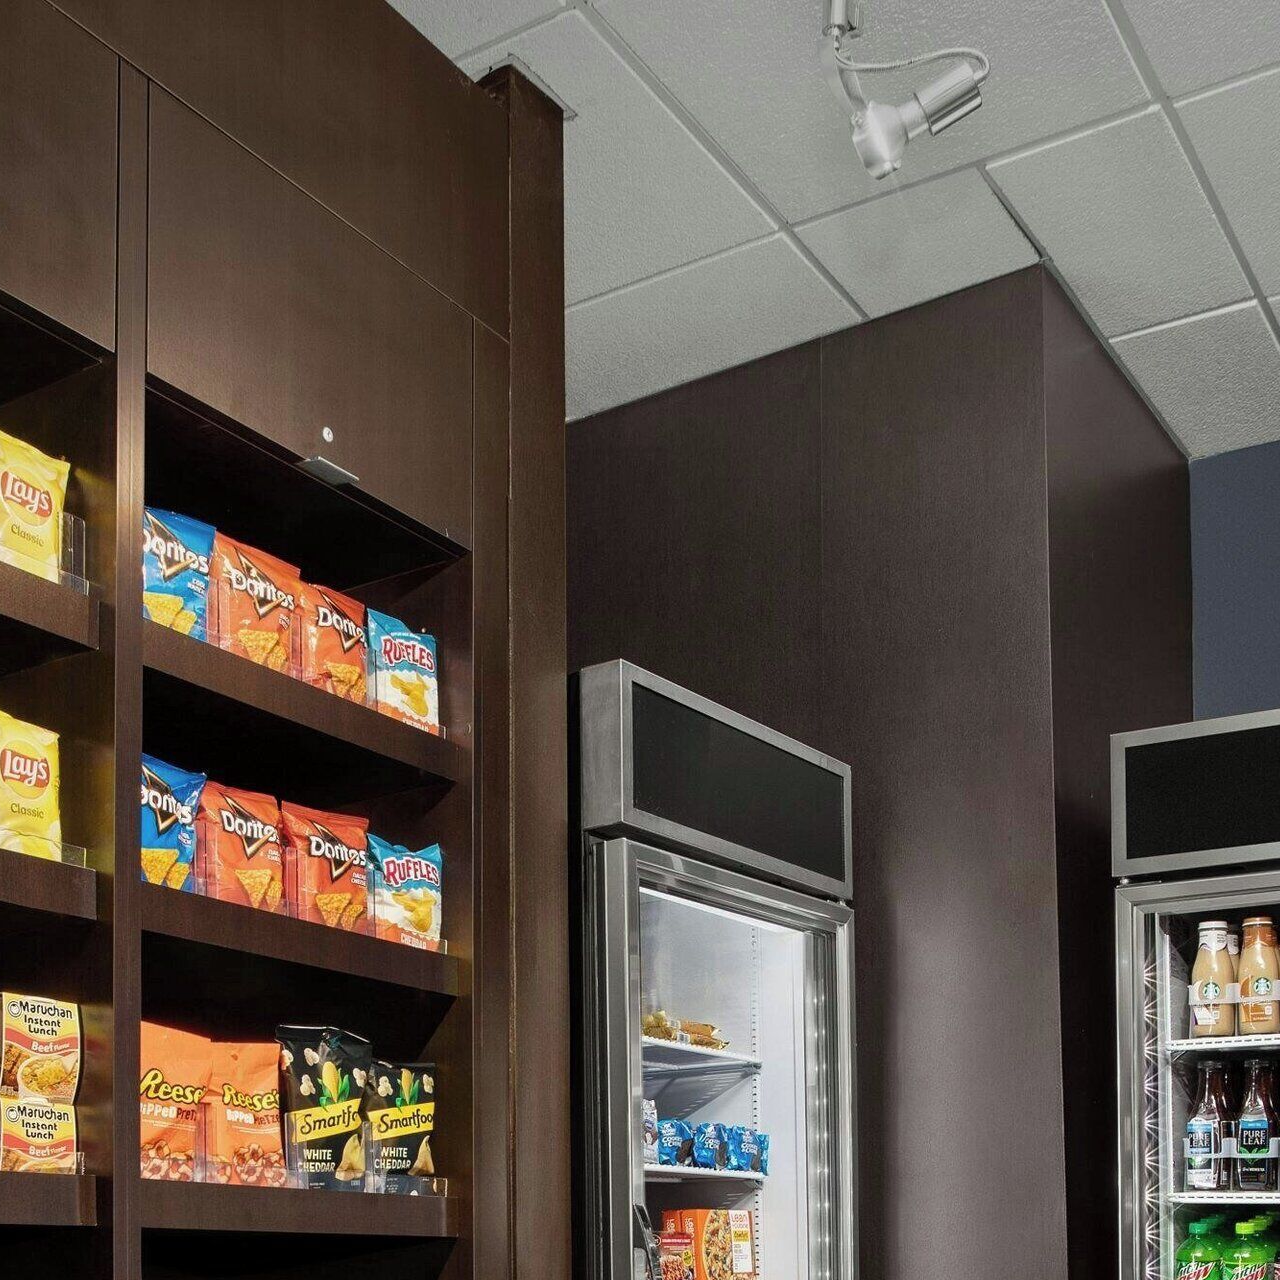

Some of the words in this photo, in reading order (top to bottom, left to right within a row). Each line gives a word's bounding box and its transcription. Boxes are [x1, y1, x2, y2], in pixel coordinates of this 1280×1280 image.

[4, 473, 51, 516] Lay's
[11, 523, 45, 547] Classic
[231, 566, 295, 610] Doritos
[382, 637, 436, 672] RUFFLES
[3, 749, 49, 788] Lay's
[11, 802, 44, 818] Classic
[310, 835, 367, 866] Doritos
[385, 856, 439, 886] RUFFLES
[18, 1001, 73, 1019] Maruchan
[24, 1015, 61, 1028] Instant
[28, 1025, 57, 1037] Lunch
[31, 1042, 53, 1052] Beef
[17, 1105, 69, 1121] Maruchan
[22, 1119, 58, 1131] Instant
[25, 1129, 54, 1140] Lunch
[1243, 1130, 1266, 1138] PURE
[29, 1145, 50, 1157] Beef
[303, 1149, 332, 1161] WHITE
[381, 1147, 408, 1158] WHITE
[297, 1161, 336, 1173] CHEDDAR
[375, 1159, 411, 1170] CHEDDAR
